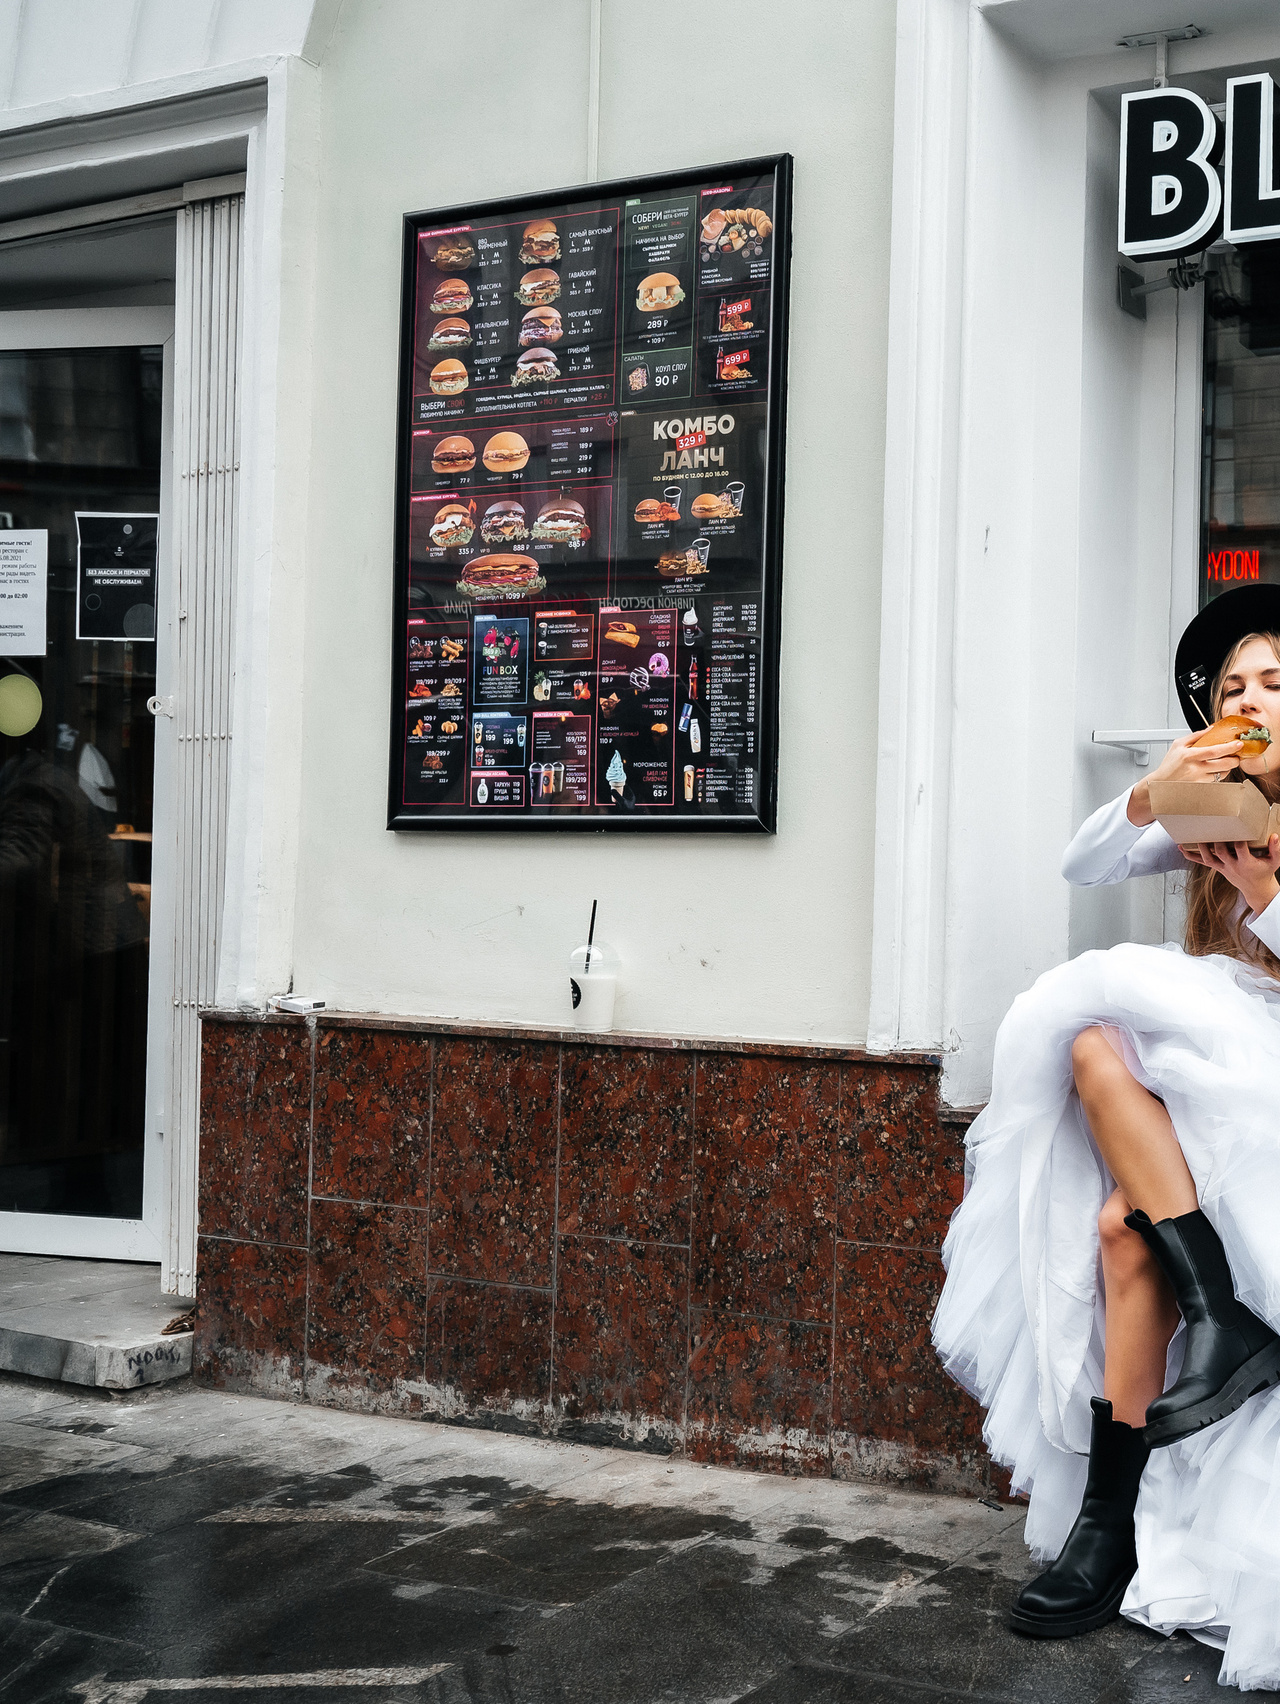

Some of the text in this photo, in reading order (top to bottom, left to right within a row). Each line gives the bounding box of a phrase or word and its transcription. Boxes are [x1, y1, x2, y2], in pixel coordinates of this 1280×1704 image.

[632, 212, 662, 224] СОБЕРИ
[569, 226, 612, 238] САМЫЙ ВКУСНЫЙ
[636, 236, 659, 245] НАЧИНКА
[569, 268, 596, 278] ГАВАЙСКИЙ
[477, 283, 501, 291] КЛАССИКА
[568, 310, 588, 318] МОСКВА
[727, 304, 742, 315] 599
[475, 319, 509, 329] ИТАЛЬЯНСКИЙ
[647, 320, 662, 329] 289
[568, 345, 589, 354] ГРИБНОЙ
[474, 357, 501, 365] ФИШБУРГЕР
[725, 354, 740, 365] 699
[655, 363, 687, 373] КОУЛ СЛОУ
[655, 375, 669, 386] 90
[421, 399, 465, 411] ВЫБЕРИ СВОЮ
[475, 403, 516, 413] ДОПОЛНИТЕЛЬНАЯ
[653, 414, 735, 440] КОМБО
[679, 436, 696, 449] 329
[660, 447, 724, 472] ЛАНЧ
[505, 592, 520, 600] 1099
[483, 665, 518, 674] FUN BOX
